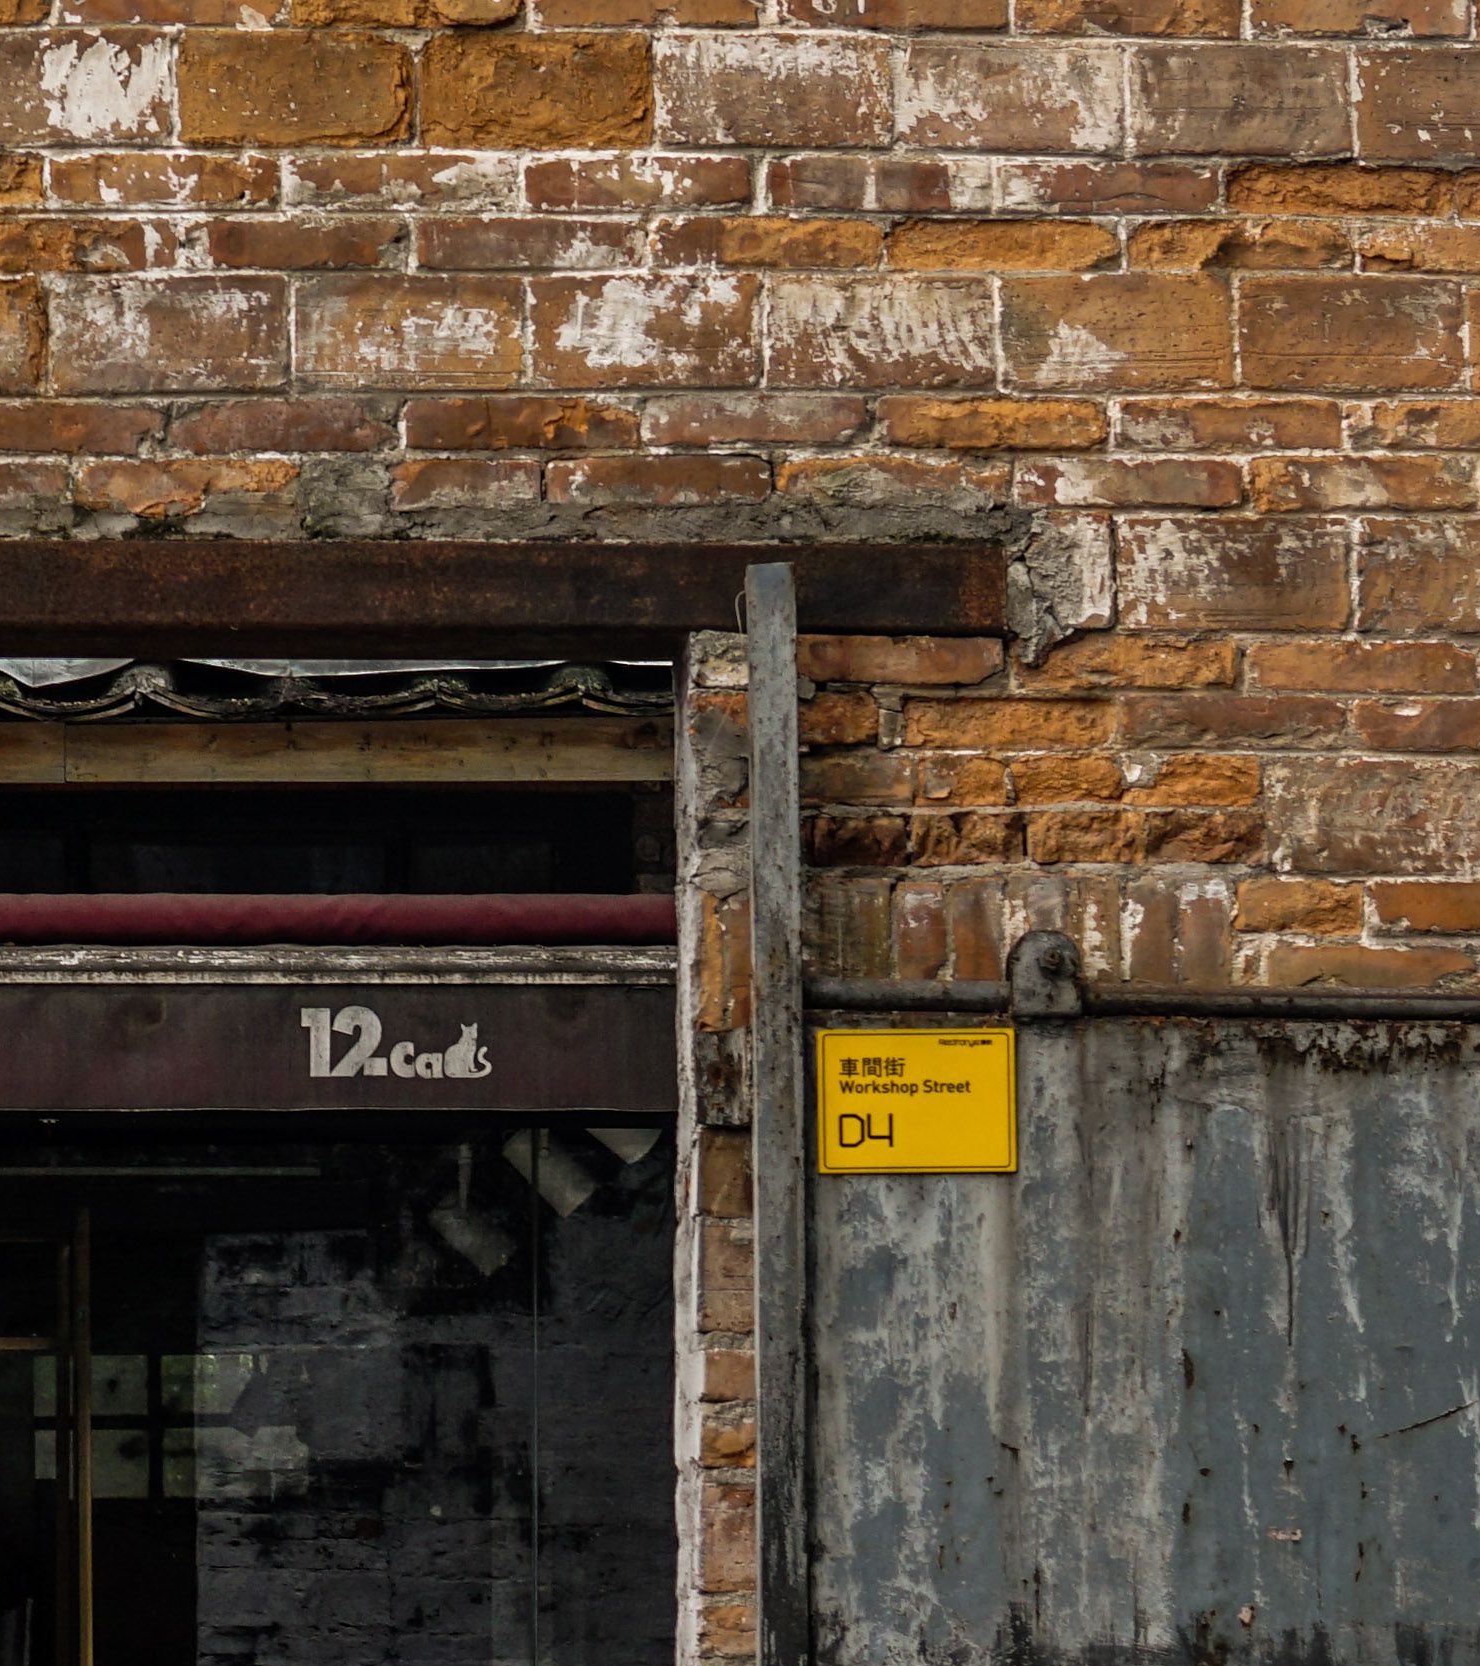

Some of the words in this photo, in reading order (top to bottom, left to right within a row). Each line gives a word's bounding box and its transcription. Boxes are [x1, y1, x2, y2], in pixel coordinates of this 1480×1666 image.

[838, 1056, 906, 1079] 車間街
[839, 1080, 919, 1097] Workshop
[922, 1079, 971, 1094] Street
[838, 1112, 894, 1148] D4
